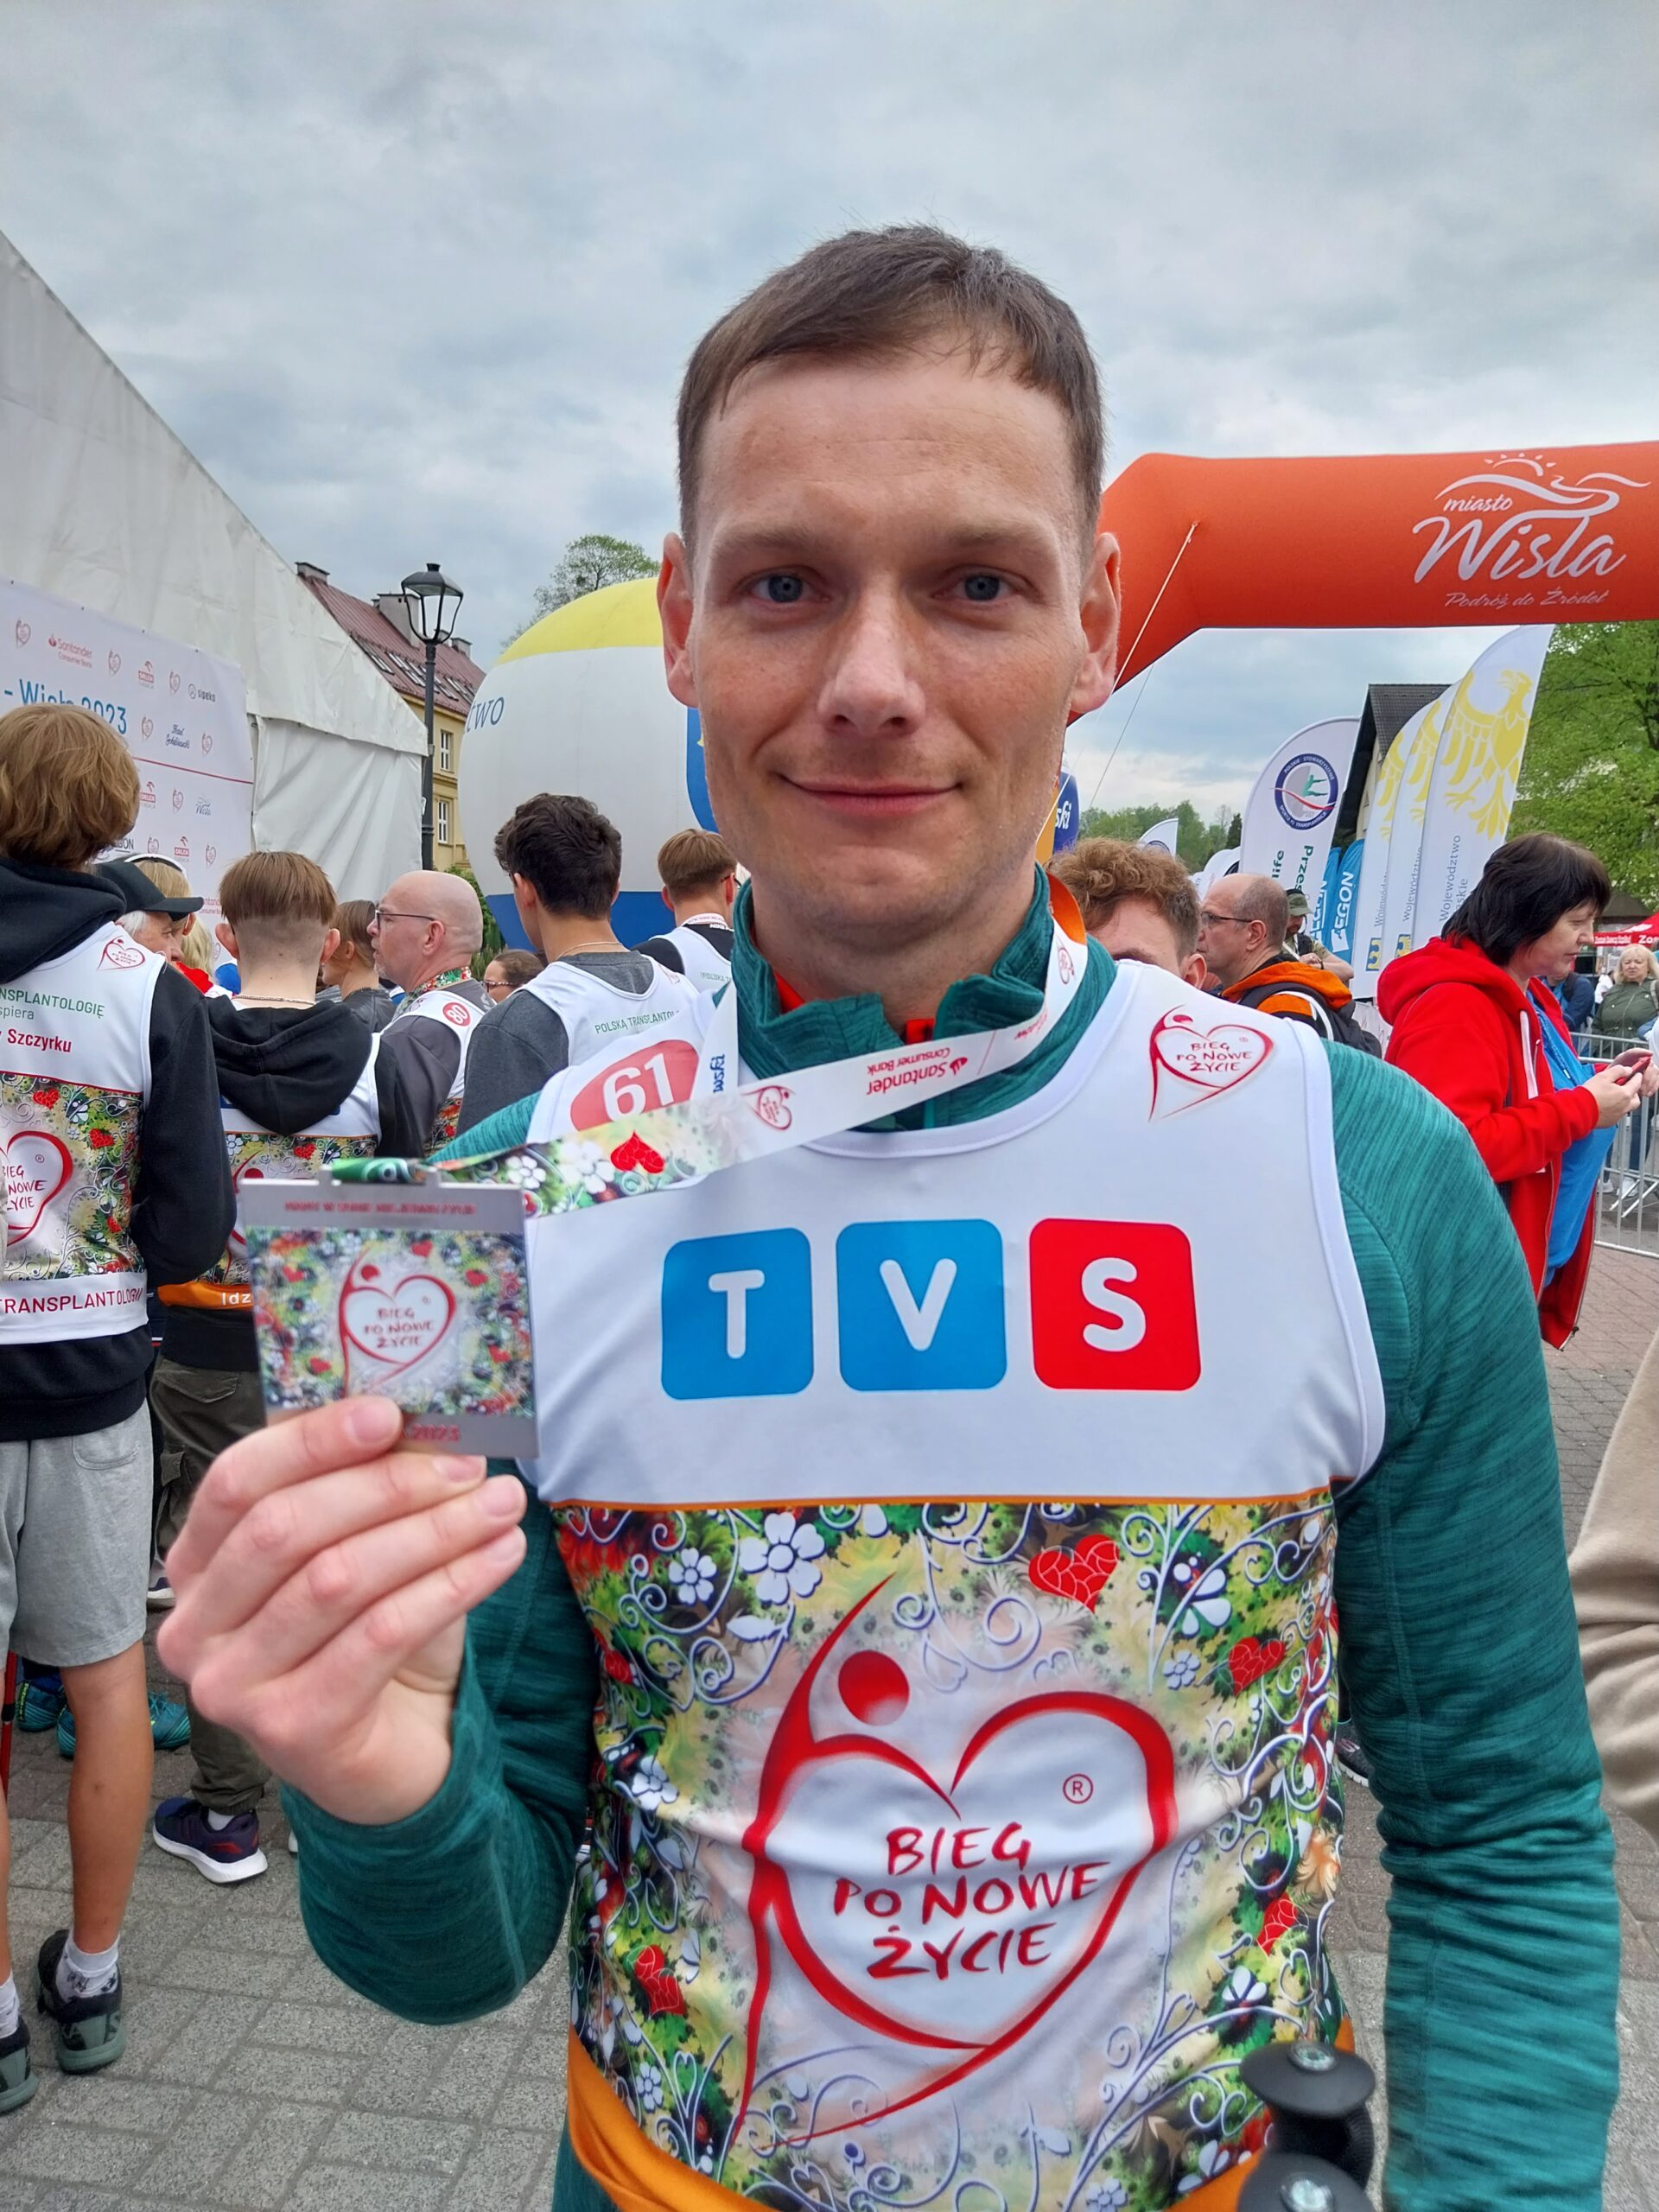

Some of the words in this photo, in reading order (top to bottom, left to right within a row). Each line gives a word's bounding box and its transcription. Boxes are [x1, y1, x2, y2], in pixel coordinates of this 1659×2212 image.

[1443, 494, 1513, 512] miasto
[1512, 593, 1535, 606] do
[1272, 850, 1285, 878] life
[1439, 835, 1461, 922] Województwo
[447, 1005, 467, 1025] 80
[594, 1020, 628, 1034] POLSKĄ
[7, 1028, 72, 1052] Szczyrku
[1191, 1041, 1230, 1052] BIEG
[897, 1047, 950, 1068] Consumer
[1190, 1060, 1241, 1072] ŻYCIE
[1203, 1051, 1252, 1061] NOWE
[867, 1060, 894, 1076] Bank
[603, 1052, 675, 1122] 61
[867, 1062, 947, 1095] Santander
[8, 1179, 48, 1196] NOWE
[7, 1196, 35, 1211] YCIE
[0, 1287, 143, 1313] RANSPLANTOLOGII
[378, 1307, 415, 1319] BIEG
[886, 1821, 1032, 1876] BIEG
[833, 1877, 902, 1917] PO
[922, 1861, 1111, 1925] NOWE
[867, 1923, 1058, 1980] ŻYCIE
